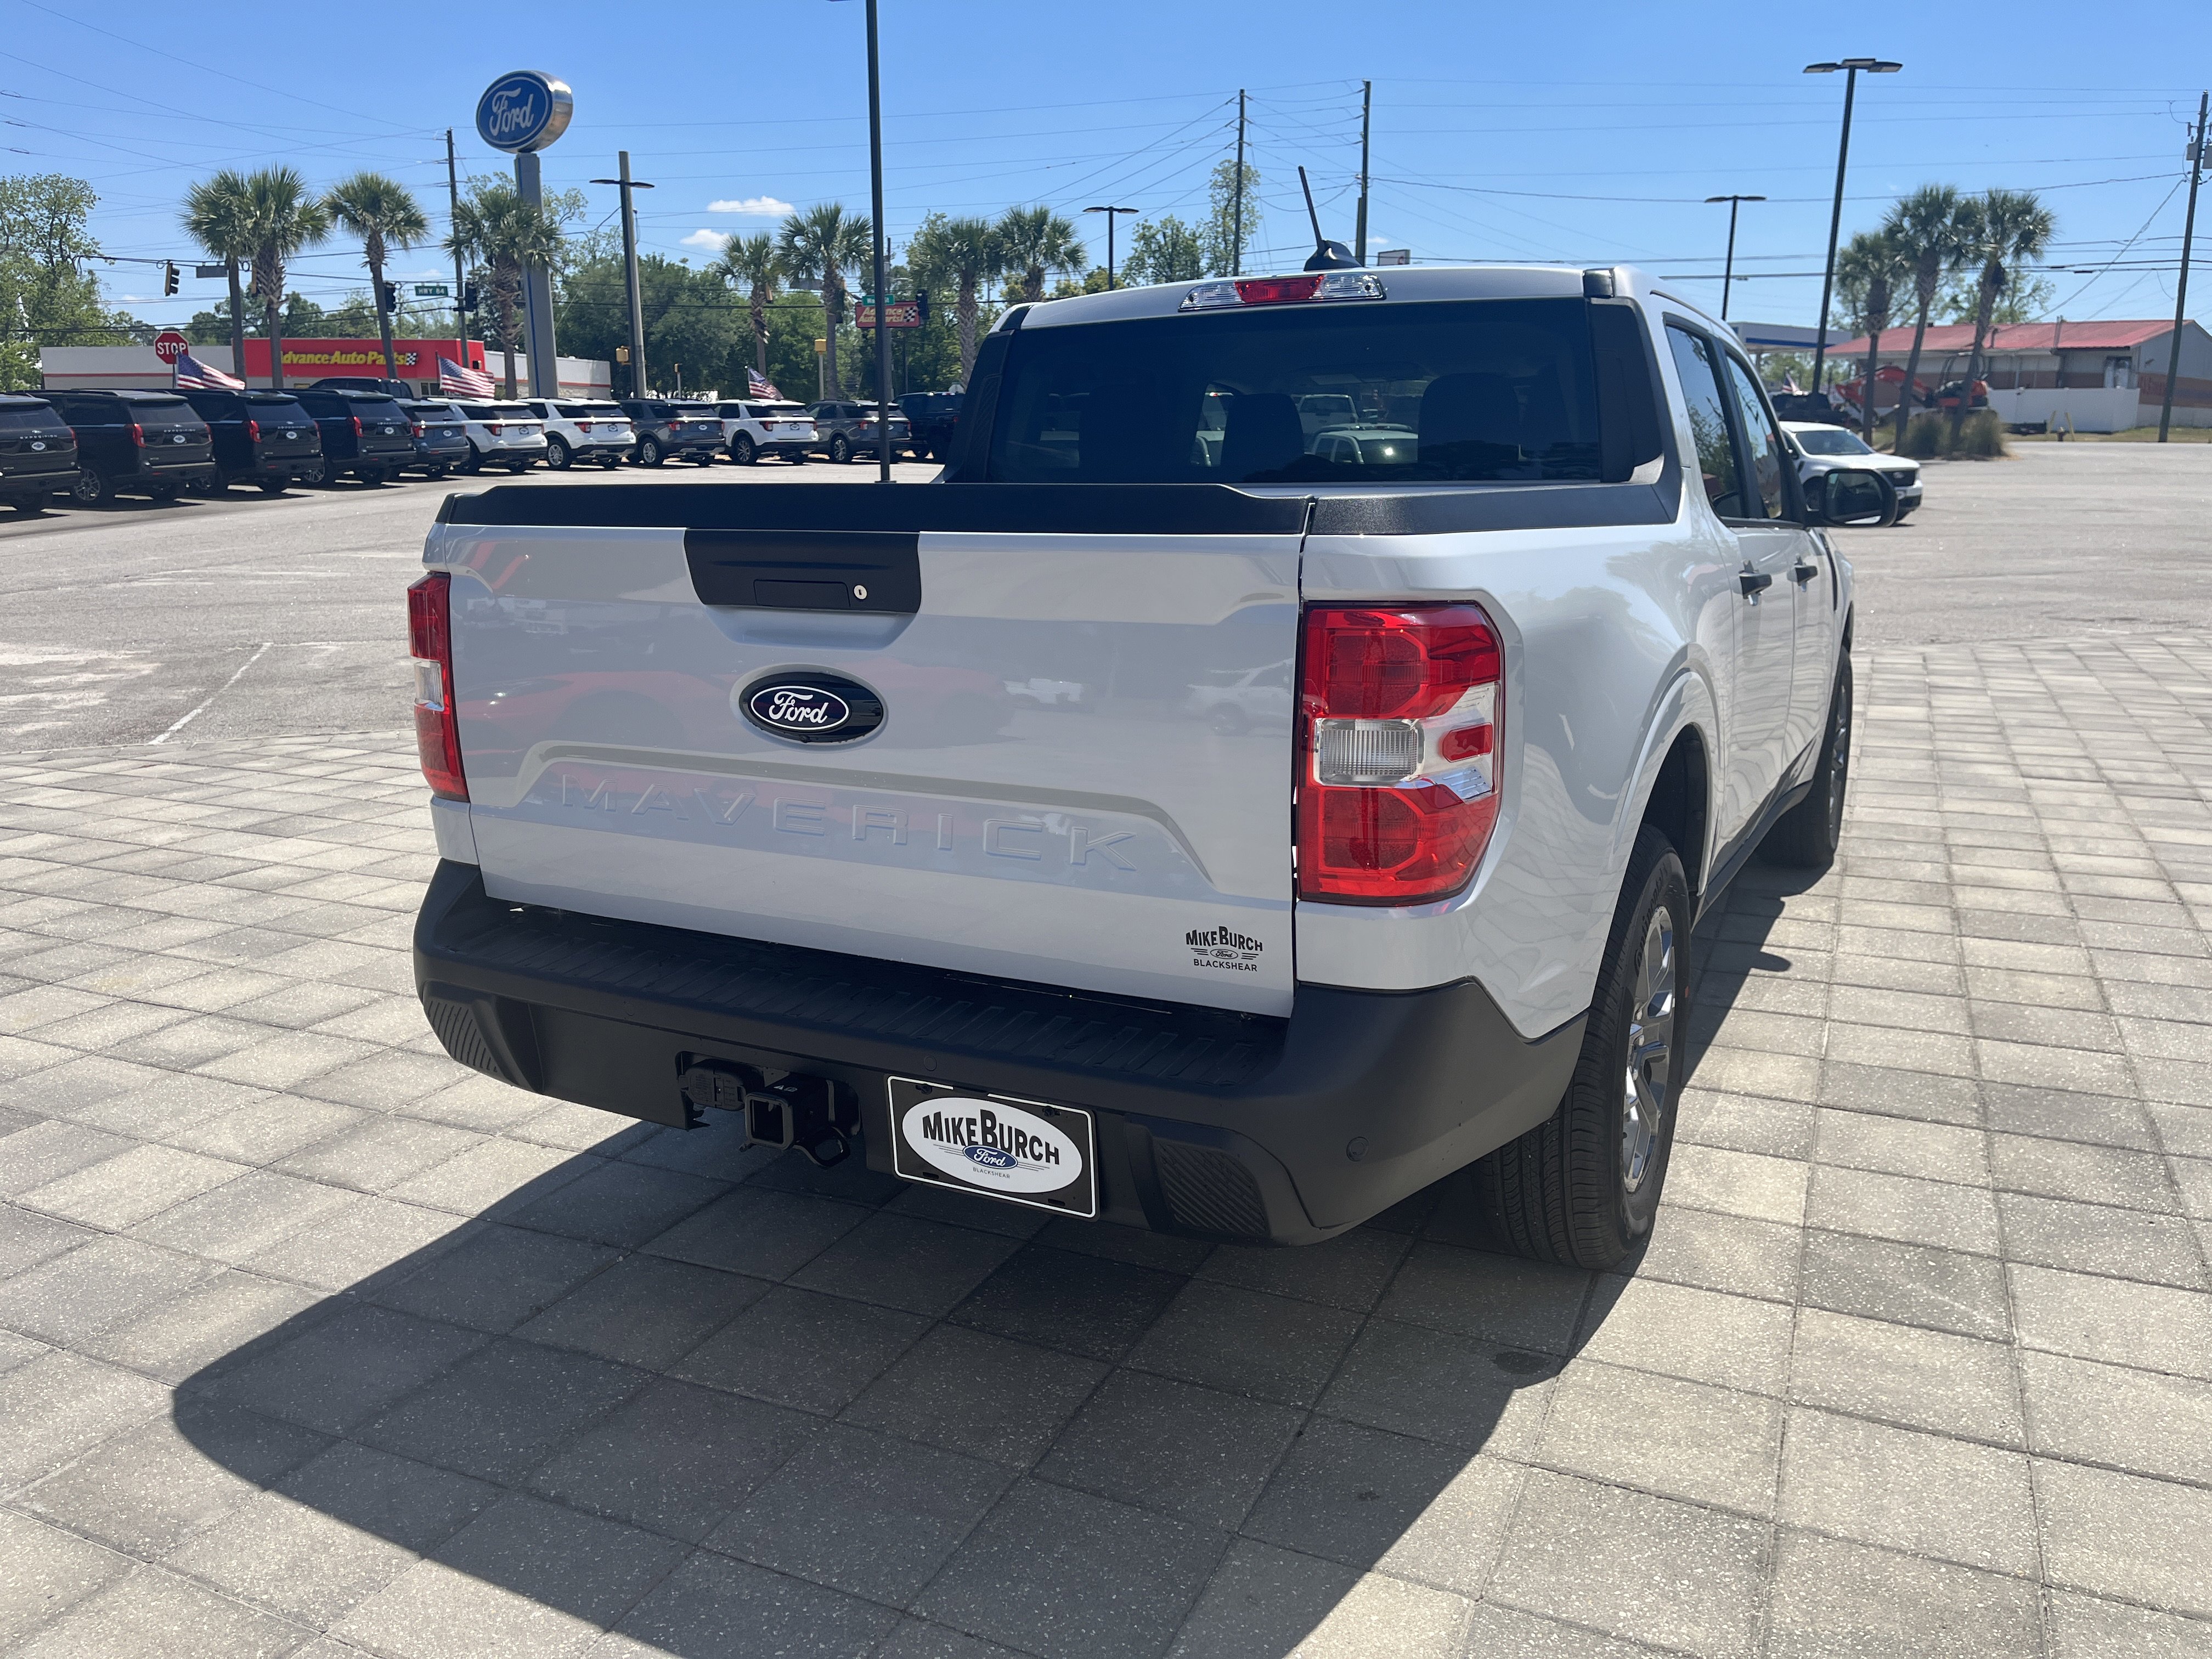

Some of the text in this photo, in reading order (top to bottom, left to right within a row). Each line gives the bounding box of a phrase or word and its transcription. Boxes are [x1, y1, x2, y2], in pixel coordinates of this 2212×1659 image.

[489, 87, 534, 136] Ford
[157, 342, 187, 355] STOP
[280, 351, 405, 365] dvance Auto Pats
[768, 691, 828, 724] Ford
[562, 774, 1138, 871] MAVERICK
[1215, 950, 1233, 958] Ford
[1193, 958, 1257, 972] BLACKSHEAR
[973, 1148, 1006, 1167] Ford
[972, 1167, 1011, 1180] BLACKSHEAR
